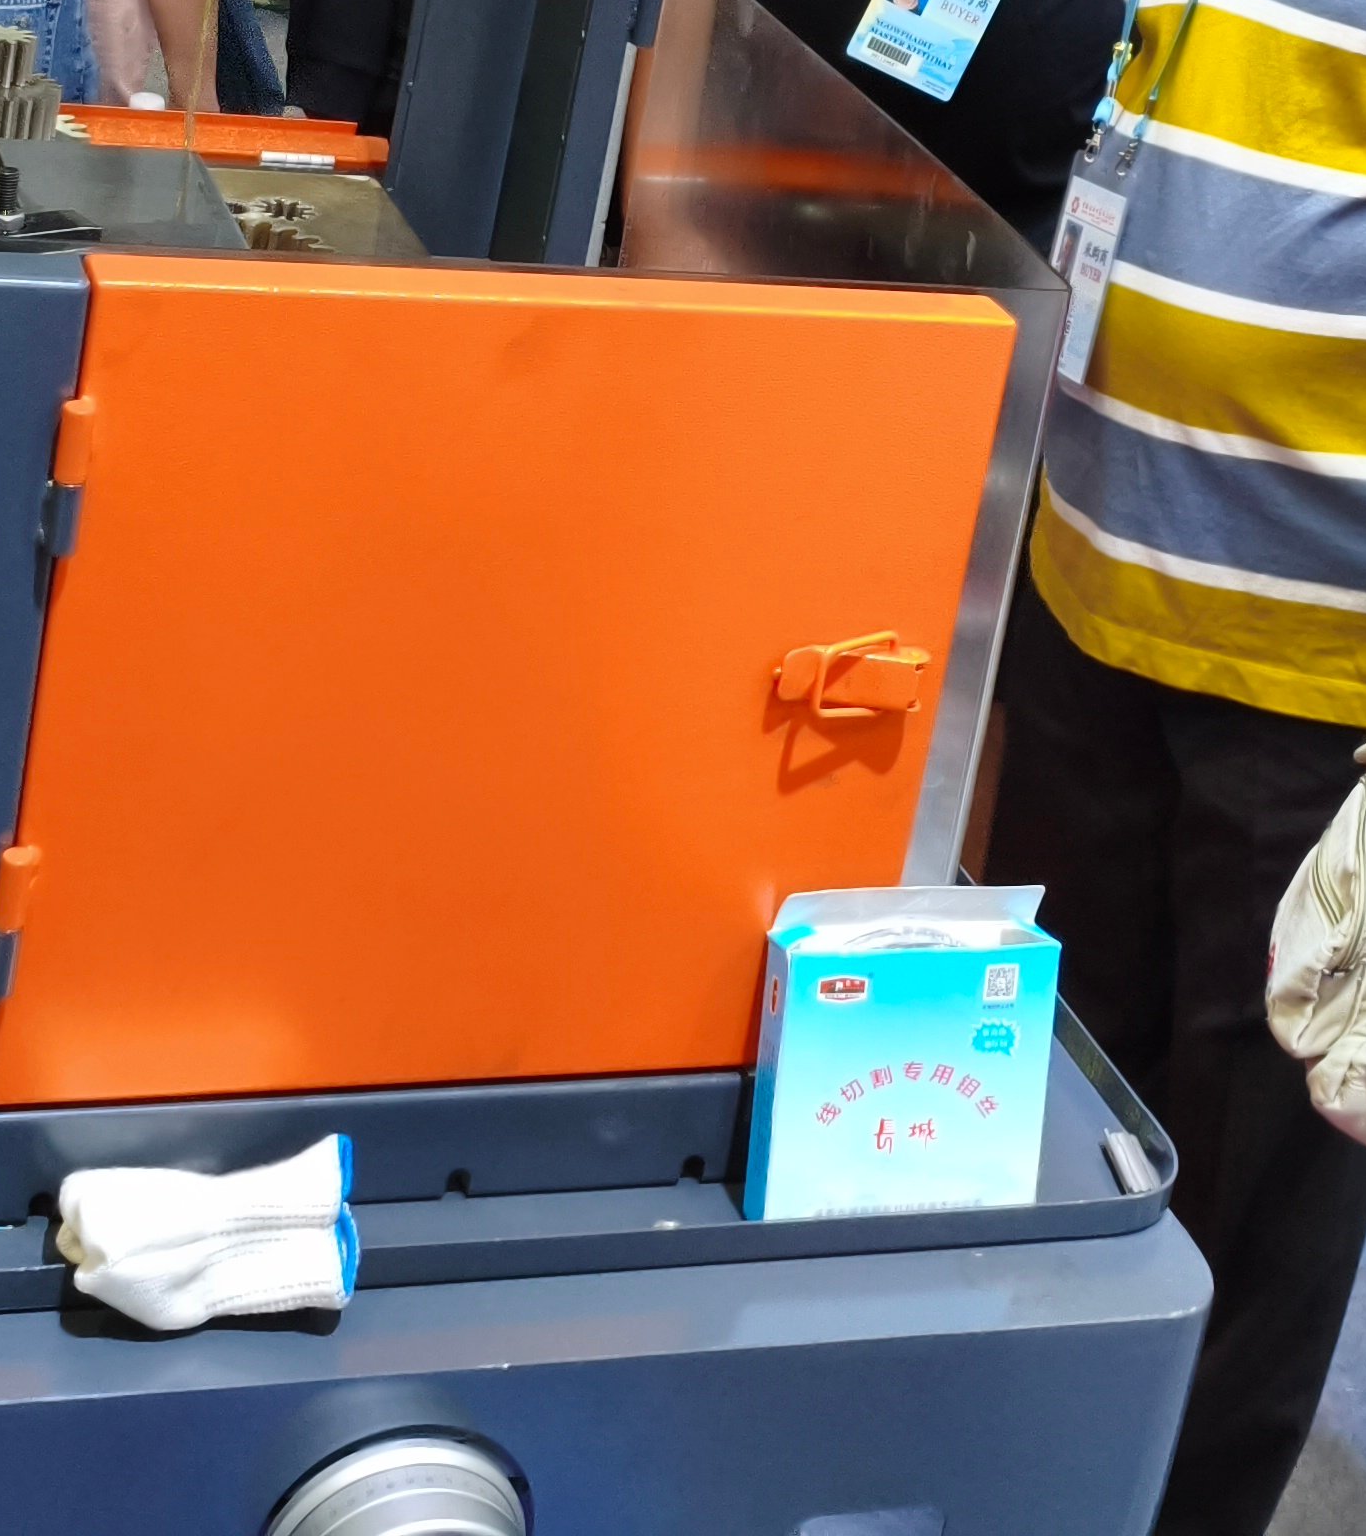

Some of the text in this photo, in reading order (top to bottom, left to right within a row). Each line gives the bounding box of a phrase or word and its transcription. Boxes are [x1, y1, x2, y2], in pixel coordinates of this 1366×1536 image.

[940, 0, 981, 26] BUYER
[815, 1061, 999, 1126] 线切割专用钼丝
